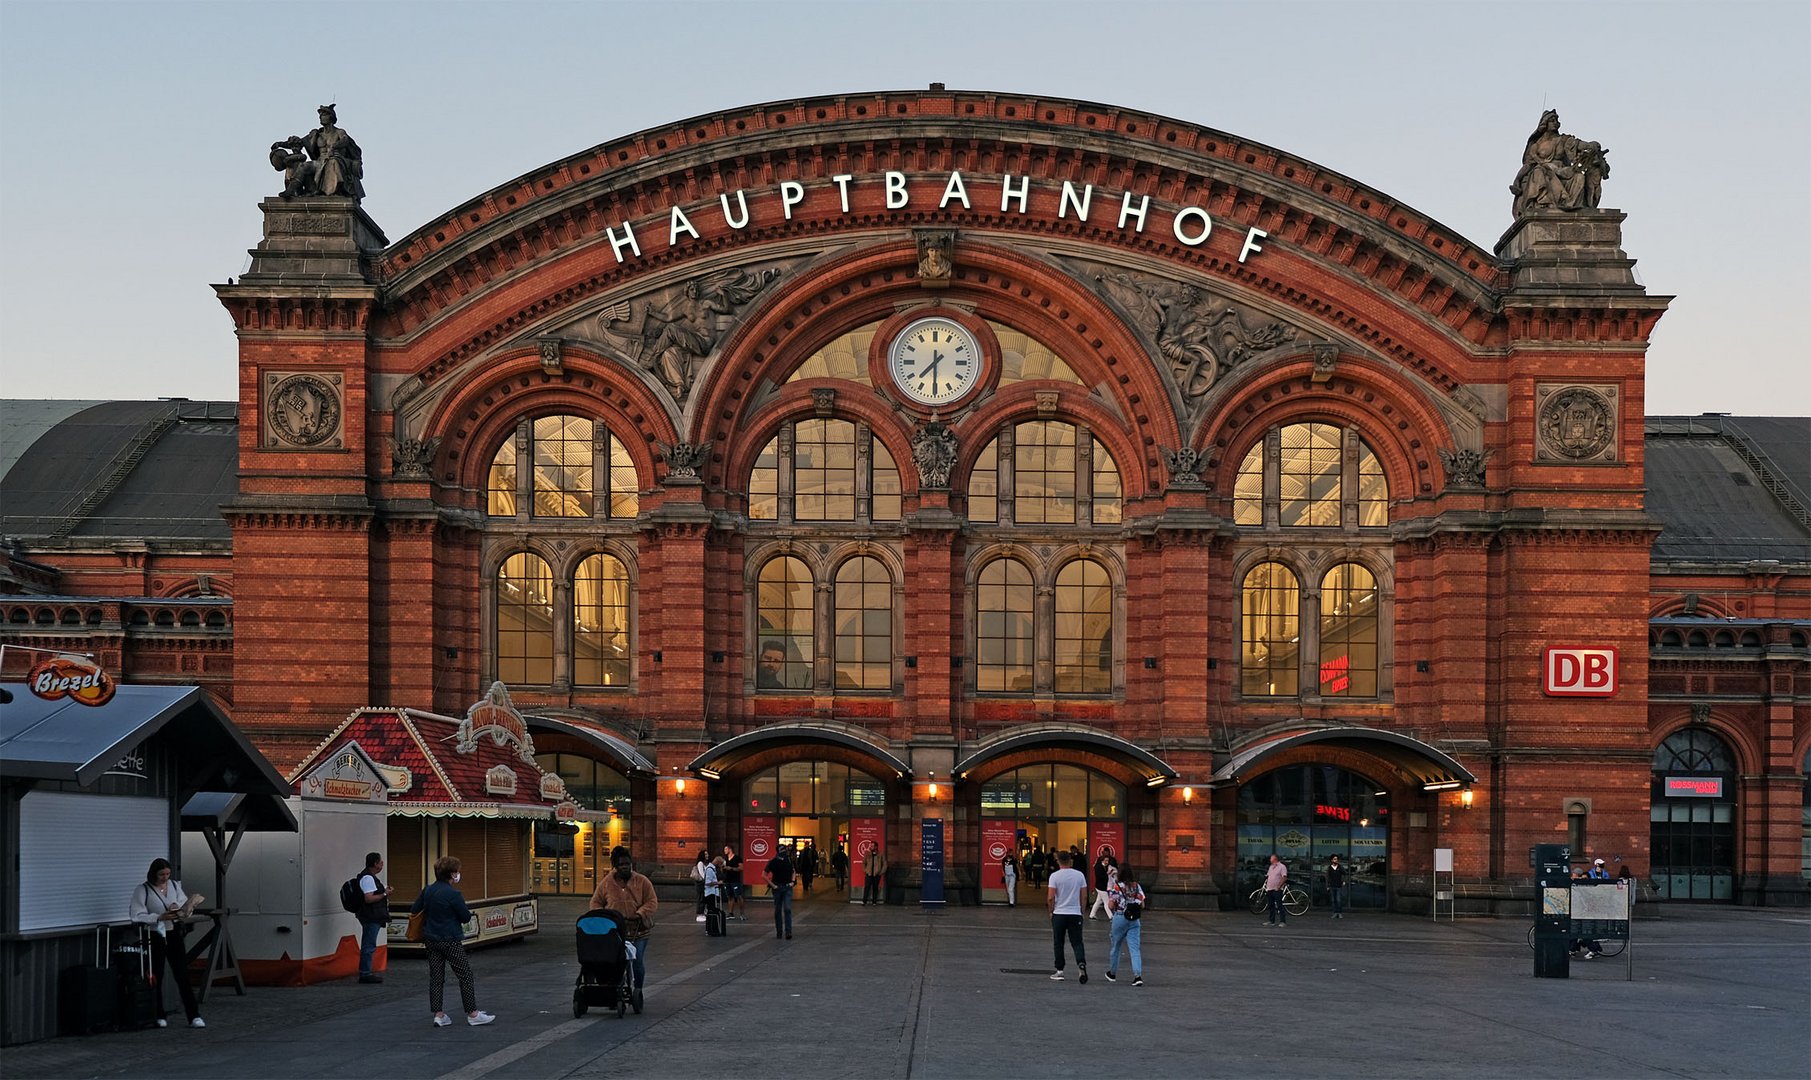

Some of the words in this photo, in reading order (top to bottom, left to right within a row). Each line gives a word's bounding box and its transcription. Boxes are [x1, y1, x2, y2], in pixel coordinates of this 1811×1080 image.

[606, 171, 1269, 264] HAUPTBAHNHOF
[34, 668, 102, 693] Brezel
[1554, 653, 1610, 688] DB
[112, 748, 144, 771] ette
[1669, 780, 1719, 790] ROSSMANN
